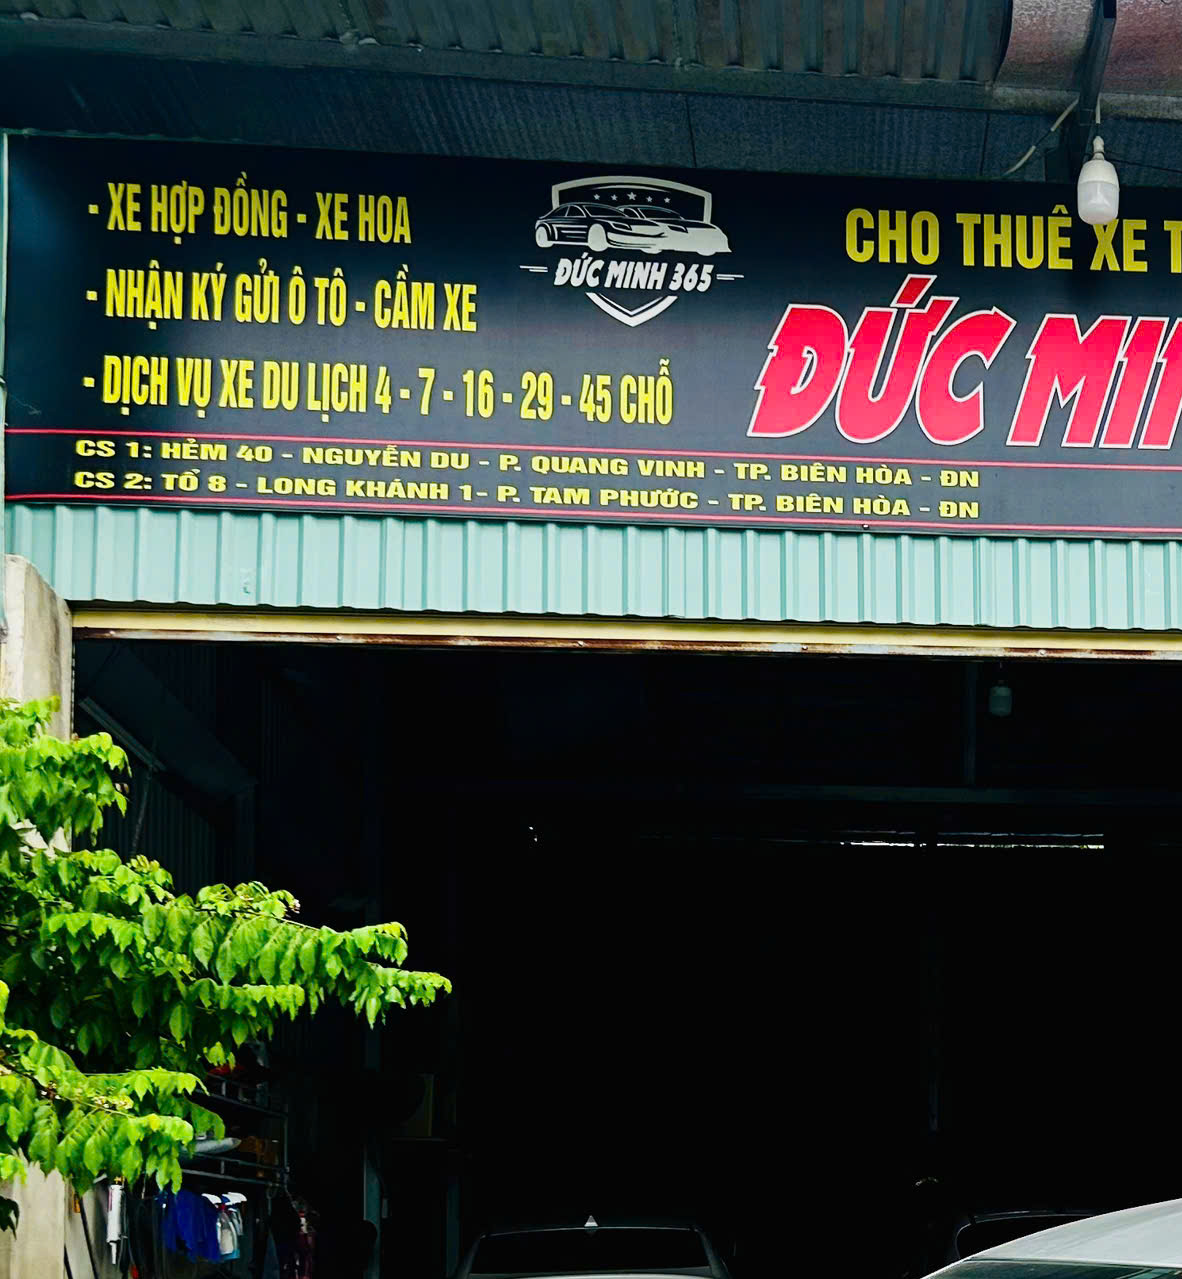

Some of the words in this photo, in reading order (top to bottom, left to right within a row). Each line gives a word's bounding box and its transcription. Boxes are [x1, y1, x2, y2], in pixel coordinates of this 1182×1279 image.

[107, 184, 141, 231] XE
[151, 181, 204, 244] HỢP
[214, 173, 287, 238] ĐỒNG
[316, 192, 348, 240] XE
[359, 195, 411, 243] HOA
[846, 209, 939, 265] CHO
[956, 205, 1072, 269] THUÊ
[1090, 219, 1147, 272] XE
[106, 260, 183, 329] NHẬN
[191, 263, 226, 321] KÝ
[234, 258, 279, 322] GỬI
[288, 266, 306, 325] Ô
[314, 268, 346, 326] TÔ
[374, 265, 434, 330] CẦM
[443, 284, 477, 332] XE
[554, 252, 604, 287] ĐỨC
[604, 261, 667, 289] MINH
[669, 263, 713, 291] 365
[103, 355, 168, 415] DỊCH
[175, 358, 211, 417] VỤ
[219, 358, 254, 408] XE
[262, 360, 299, 410] DU
[305, 362, 367, 422] LỊCH
[375, 367, 391, 413] 4
[419, 367, 435, 416] 7
[463, 369, 494, 418] 16
[520, 372, 554, 420] 29
[578, 374, 612, 423] 45
[619, 359, 674, 425] CHỖ
[747, 274, 1017, 445] ĐỨC
[74, 472, 114, 488] CS
[123, 473, 151, 489] 2:
[162, 469, 200, 491] TỔ
[208, 475, 226, 491] 8
[256, 476, 336, 496] LONG
[346, 478, 448, 501] KHÁNH
[496, 486, 518, 501] P.
[532, 486, 590, 504] TAM
[600, 488, 697, 509] PHƯỚC
[728, 493, 766, 511] TP.
[776, 494, 843, 513] BIÊN
[854, 496, 910, 515] HÒA
[938, 502, 979, 517] ĐN
[76, 440, 115, 456] CS
[127, 442, 151, 457] 1:
[160, 439, 227, 460] HẺM
[237, 445, 272, 462] 40
[302, 445, 421, 467] NGUYỄN
[430, 451, 469, 471] DU
[499, 454, 520, 472] P.
[532, 456, 628, 475] QUANG
[638, 459, 705, 478] VINH
[736, 462, 769, 480] TP.
[780, 463, 846, 482] BIÊN
[856, 465, 912, 484] HÒA
[940, 470, 979, 487] ĐN
